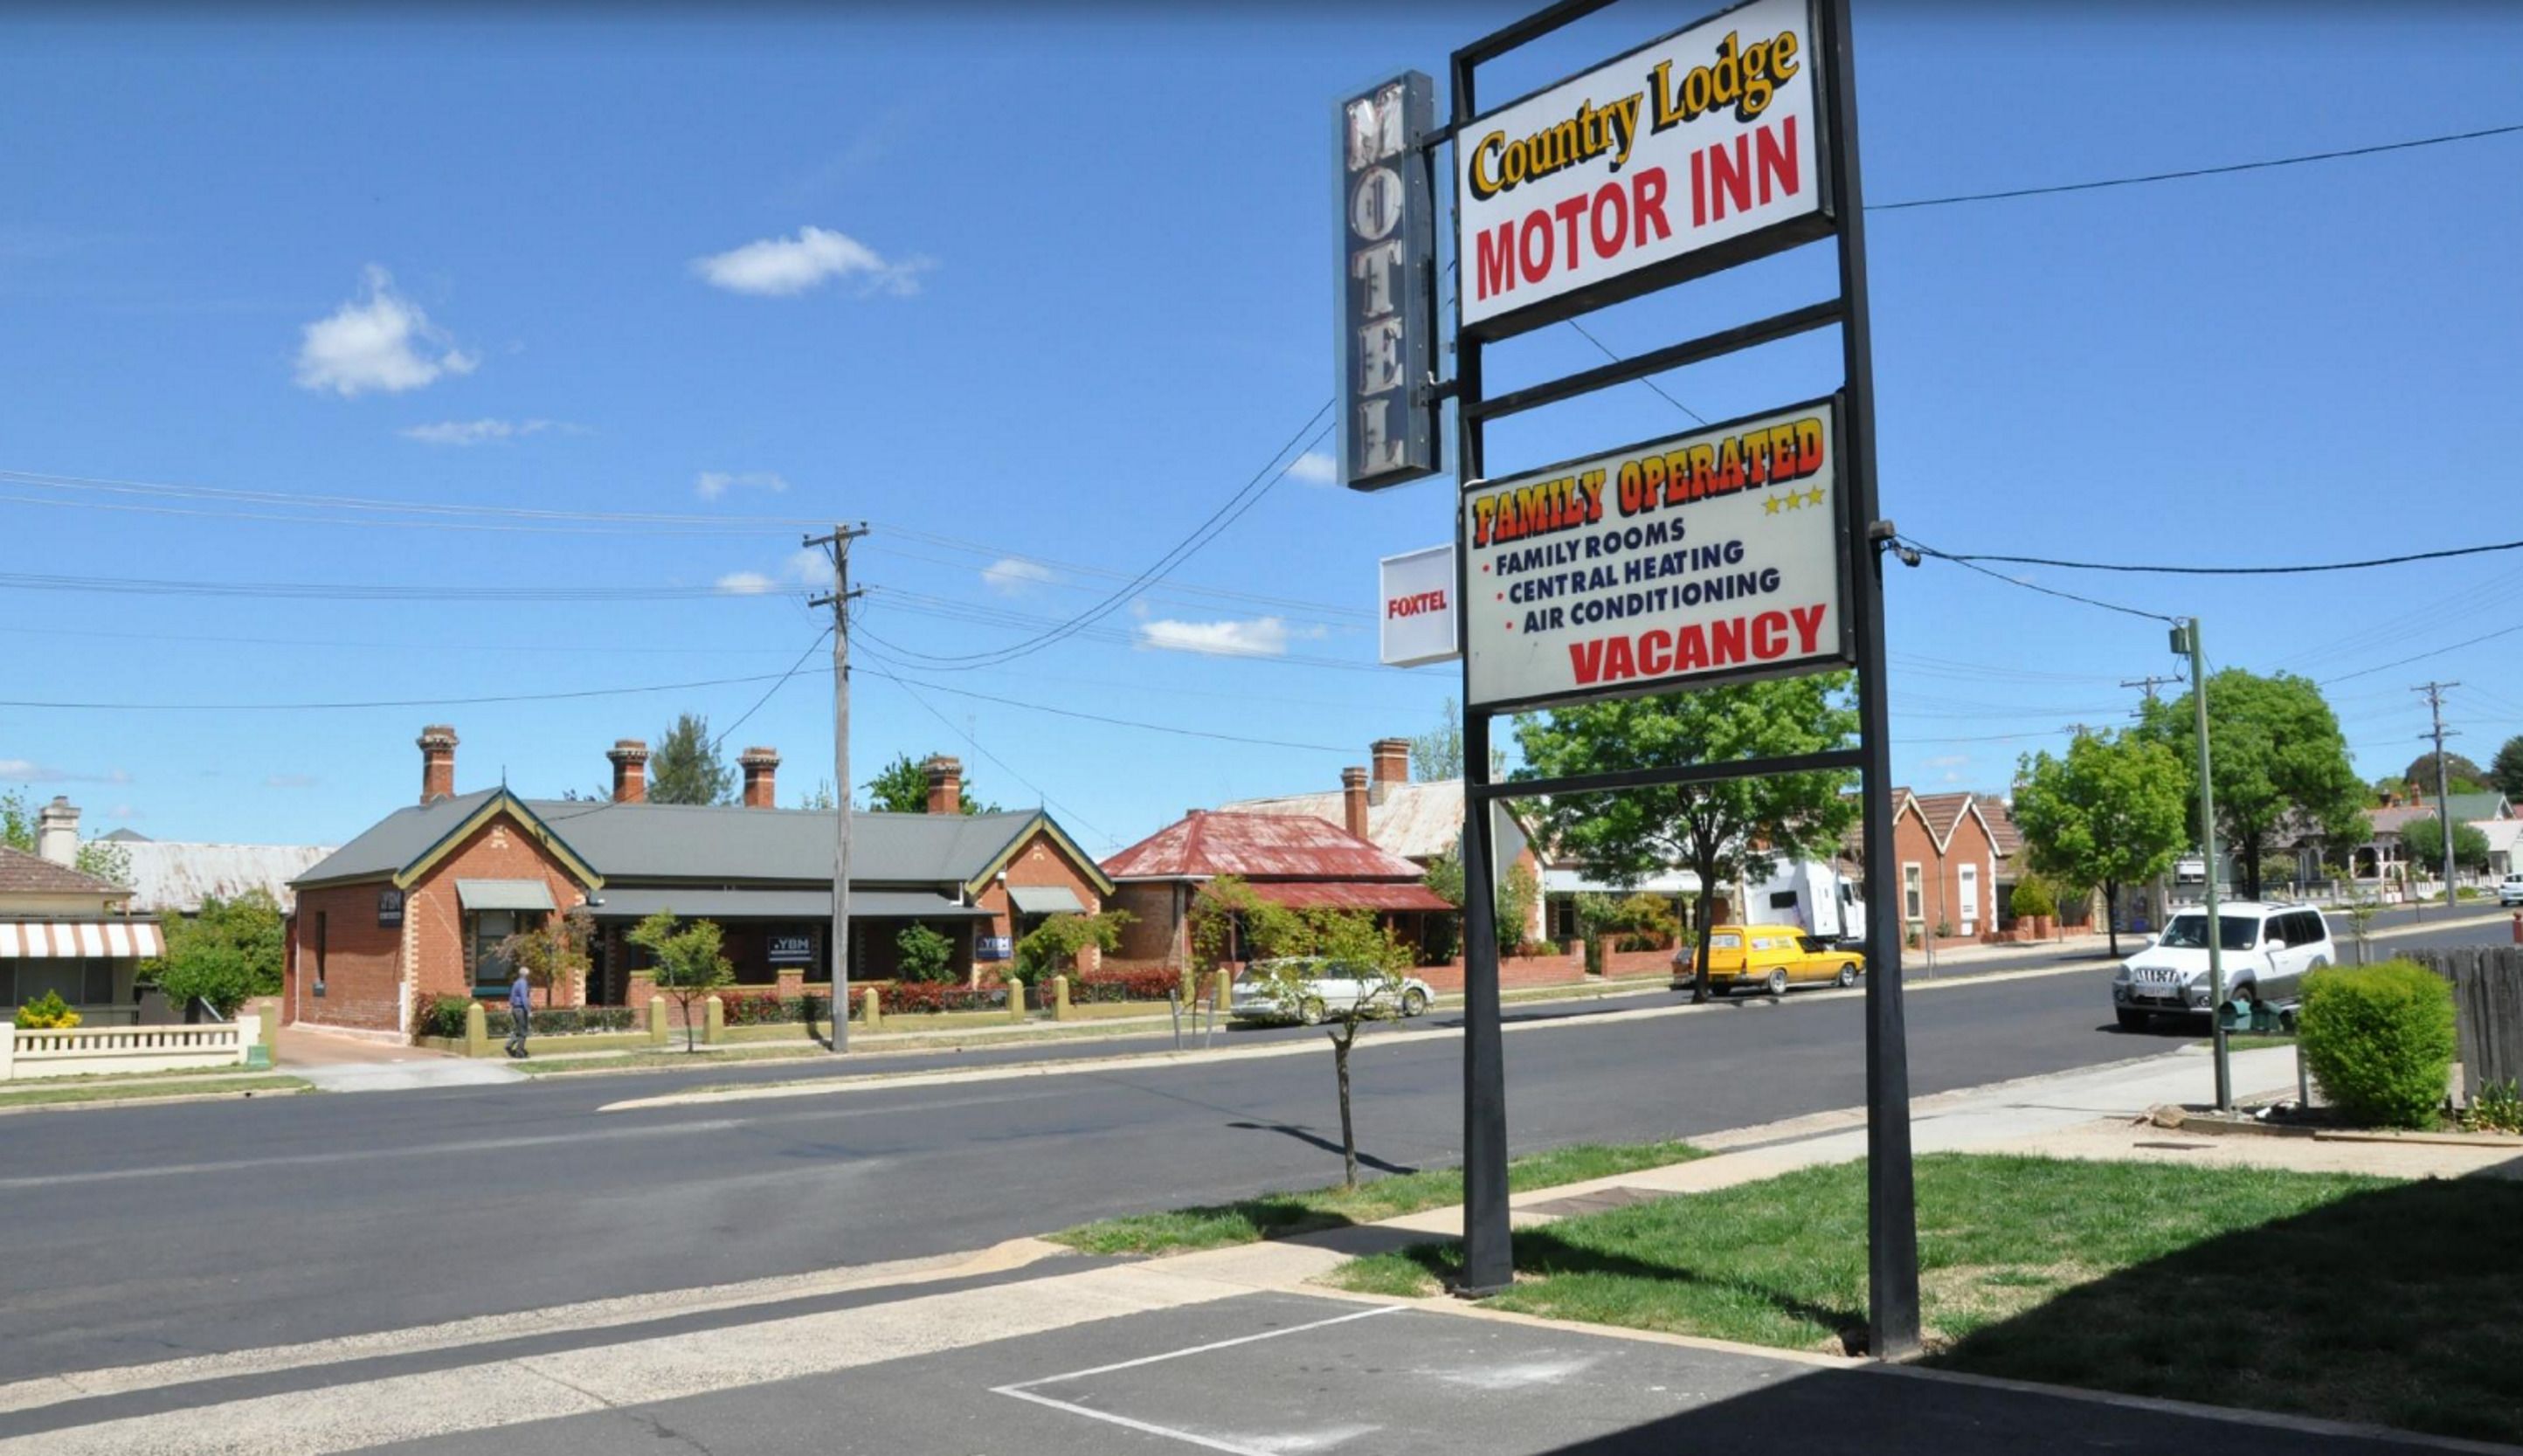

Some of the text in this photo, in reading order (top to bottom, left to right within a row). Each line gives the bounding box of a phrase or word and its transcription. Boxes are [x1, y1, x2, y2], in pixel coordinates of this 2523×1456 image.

[1469, 31, 1800, 201] Country Lodge
[1476, 115, 1800, 300] MOTOR INN
[1347, 85, 1404, 474] MOTEL
[1474, 417, 1824, 549] FAMILY OPERATED
[1497, 518, 1684, 576] FAMILY ROOMS
[1510, 540, 1744, 604] CENTRAL HEATING
[1388, 590, 1447, 619] FOXTEL
[1524, 568, 1781, 635] AIR CONDITIONING
[1569, 604, 1827, 686] VACANCY
